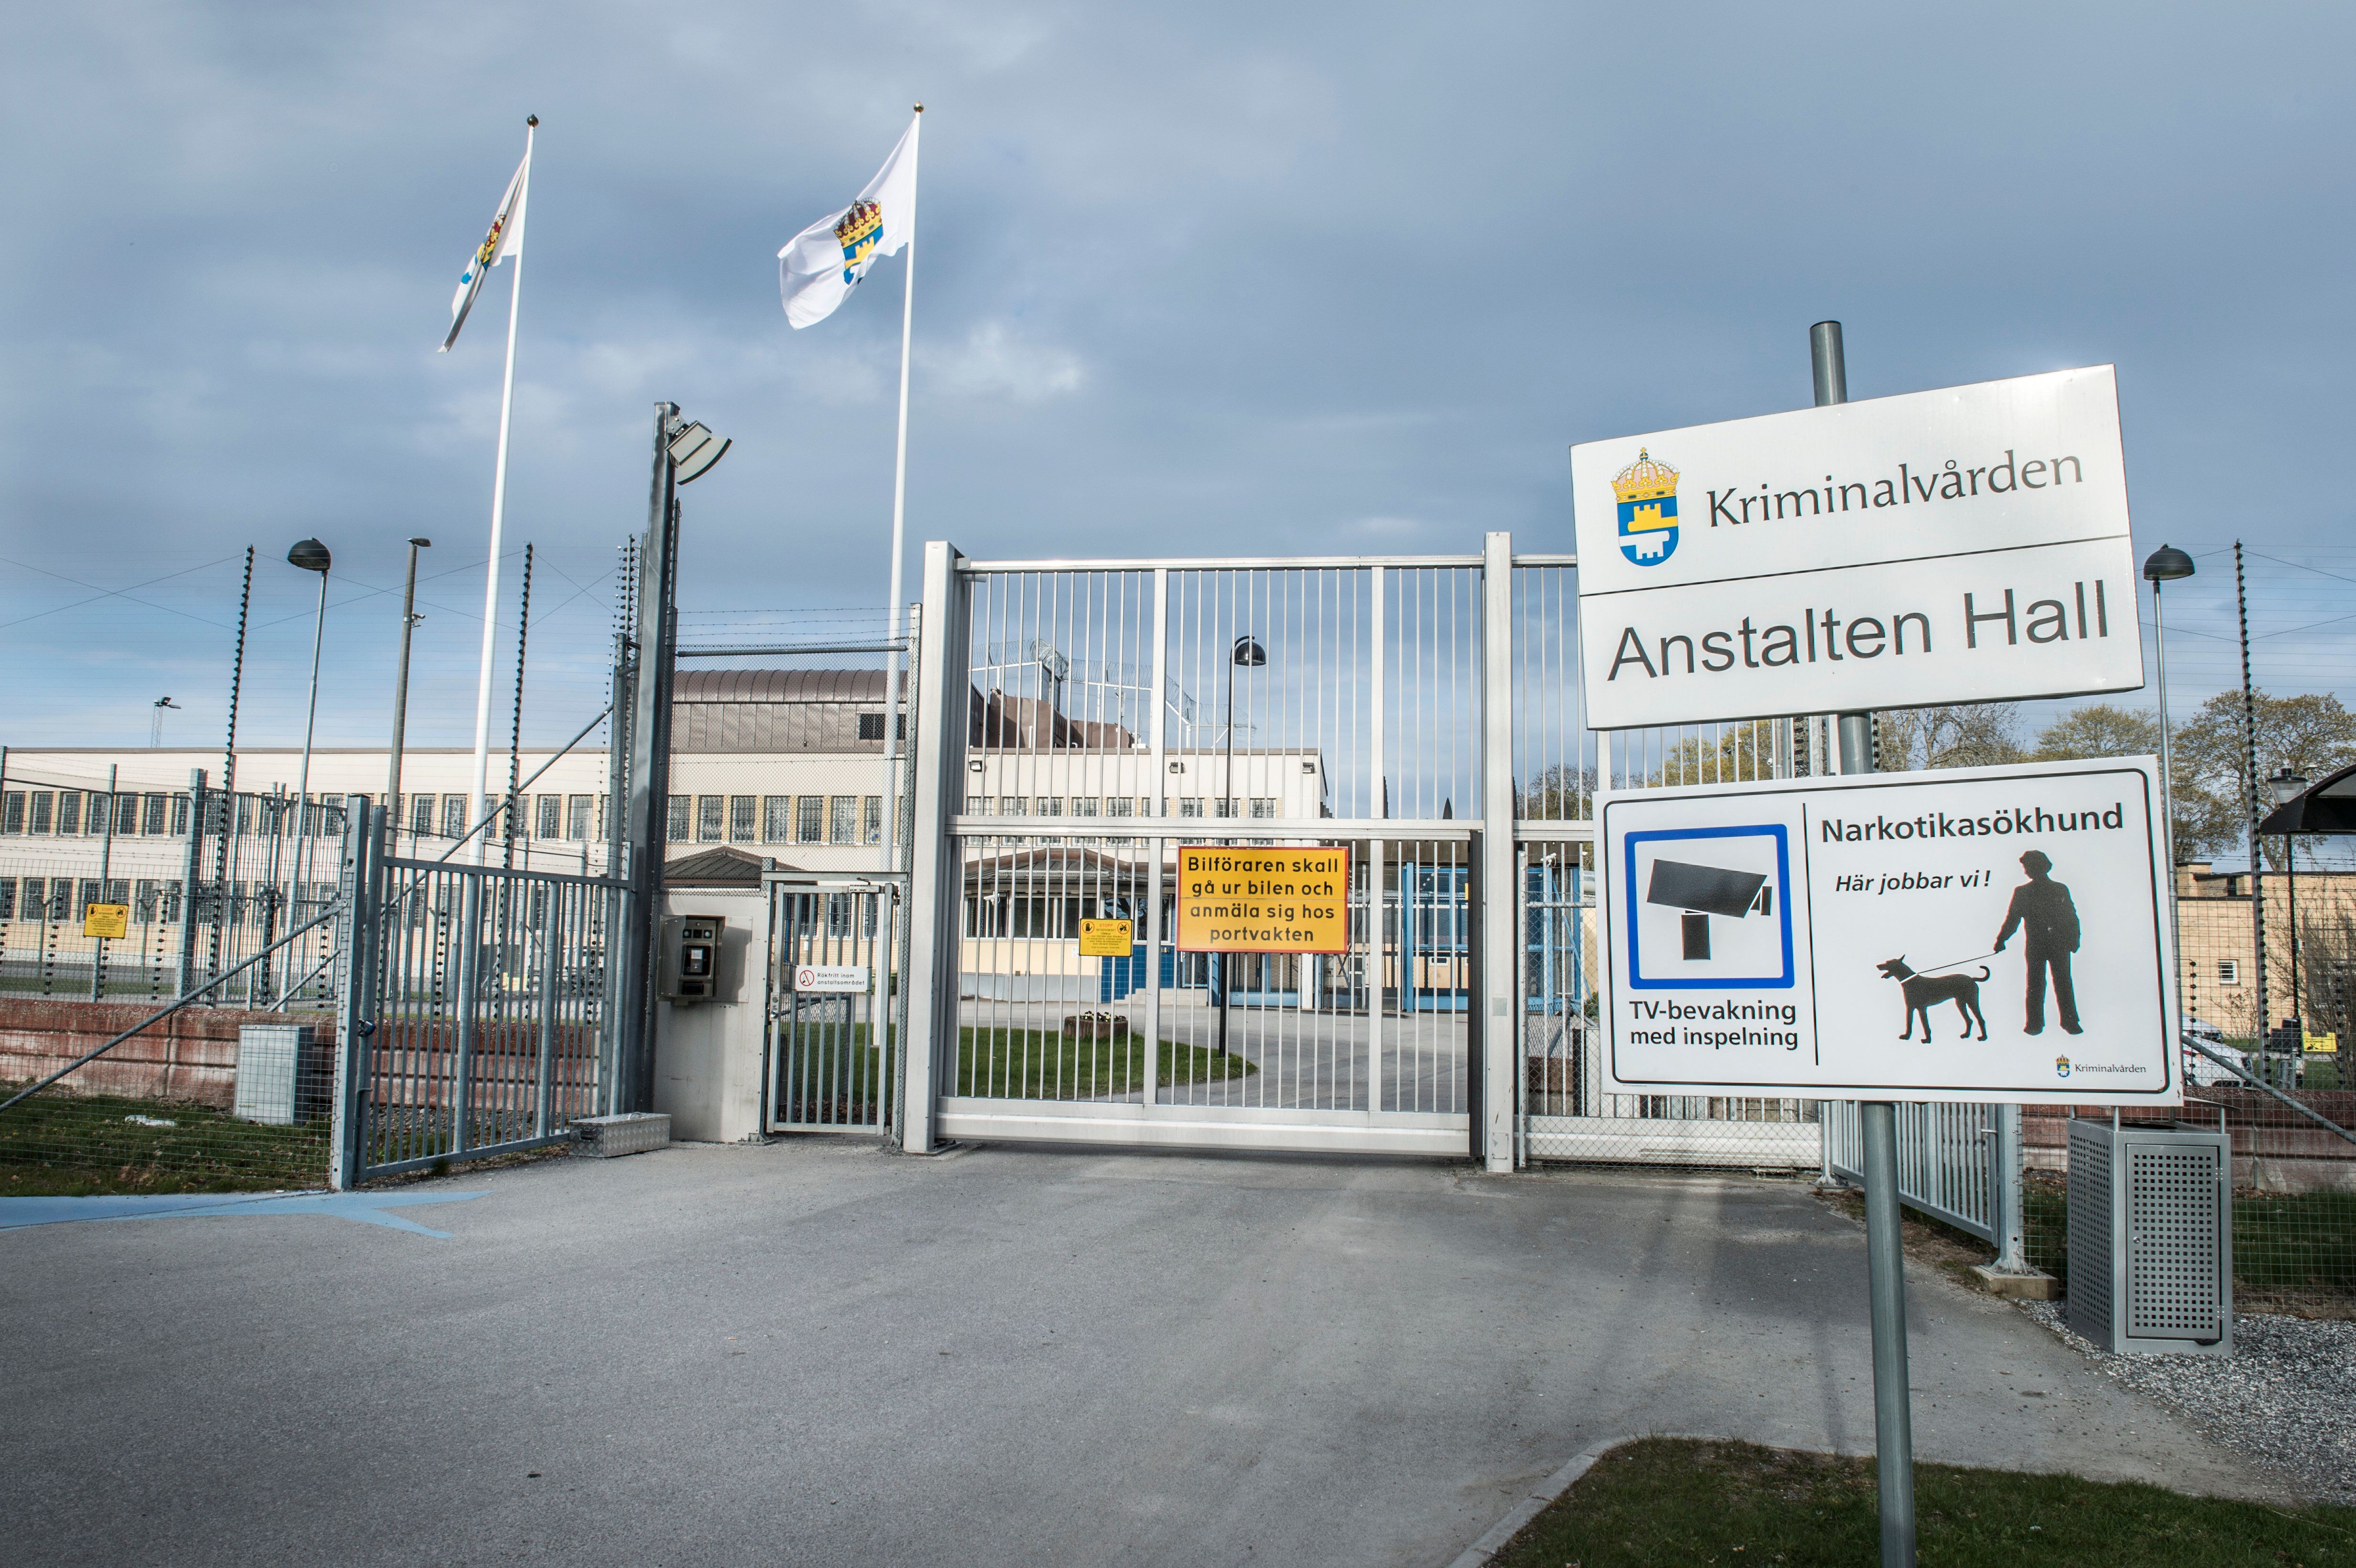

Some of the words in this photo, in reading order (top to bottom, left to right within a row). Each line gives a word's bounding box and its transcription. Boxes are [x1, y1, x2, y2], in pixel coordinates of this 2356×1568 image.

[1706, 449, 2083, 528] Kriminalvården
[1607, 608, 1931, 682] Anstalten
[1963, 579, 2108, 649] Hall
[1821, 802, 2123, 843] Narkotikasökhund
[1188, 856, 1285, 873] Bilföraren
[1292, 858, 1338, 873] skall
[1191, 879, 1215, 898] gå
[1222, 883, 1242, 895] ur
[1248, 880, 1294, 895] bilen
[1301, 881, 1333, 896] och
[1835, 873, 1875, 892] Här
[1877, 871, 1954, 895] jobbar
[1190, 902, 1260, 918] anmäla
[1266, 904, 1295, 922] sig
[1302, 904, 1335, 919] hos
[1210, 926, 1314, 944] portvakten
[1628, 999, 1797, 1026] TV-bevakning
[1630, 1026, 1676, 1045] med
[1683, 1026, 1799, 1051] inspelning
[2075, 1064, 2146, 1073] Kriminalvården
